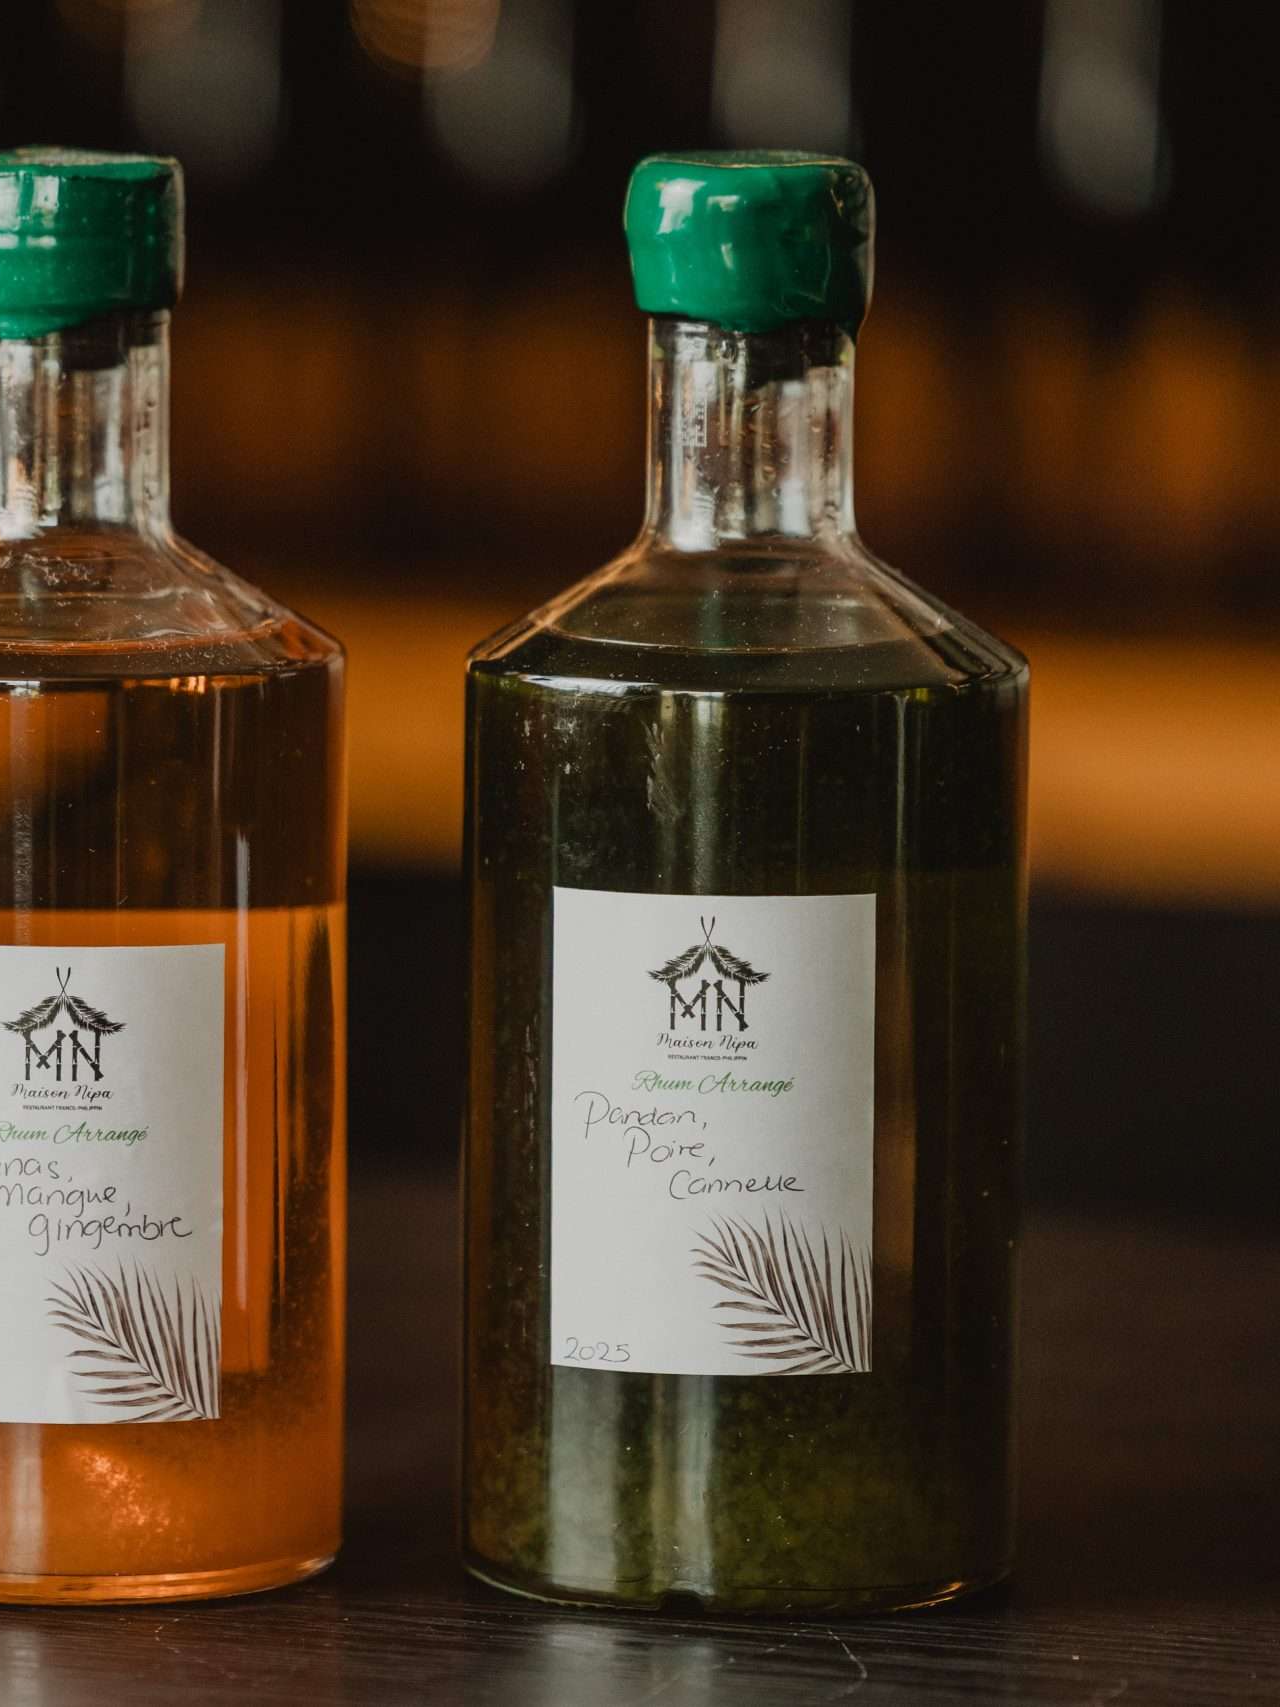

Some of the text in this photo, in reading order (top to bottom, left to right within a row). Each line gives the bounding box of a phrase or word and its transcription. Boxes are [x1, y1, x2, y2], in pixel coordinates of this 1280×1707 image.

[656, 1032, 759, 1053] Maison Nipa
[10, 1083, 115, 1102] Maison Nipa
[631, 1069, 796, 1098] Rhum Arrangé
[573, 1090, 708, 1140] Pandan,
[53, 1121, 150, 1147] Arrangé
[622, 1125, 717, 1168] Poire,
[669, 1169, 806, 1200] Cannelle
[563, 1336, 632, 1363] 2025
